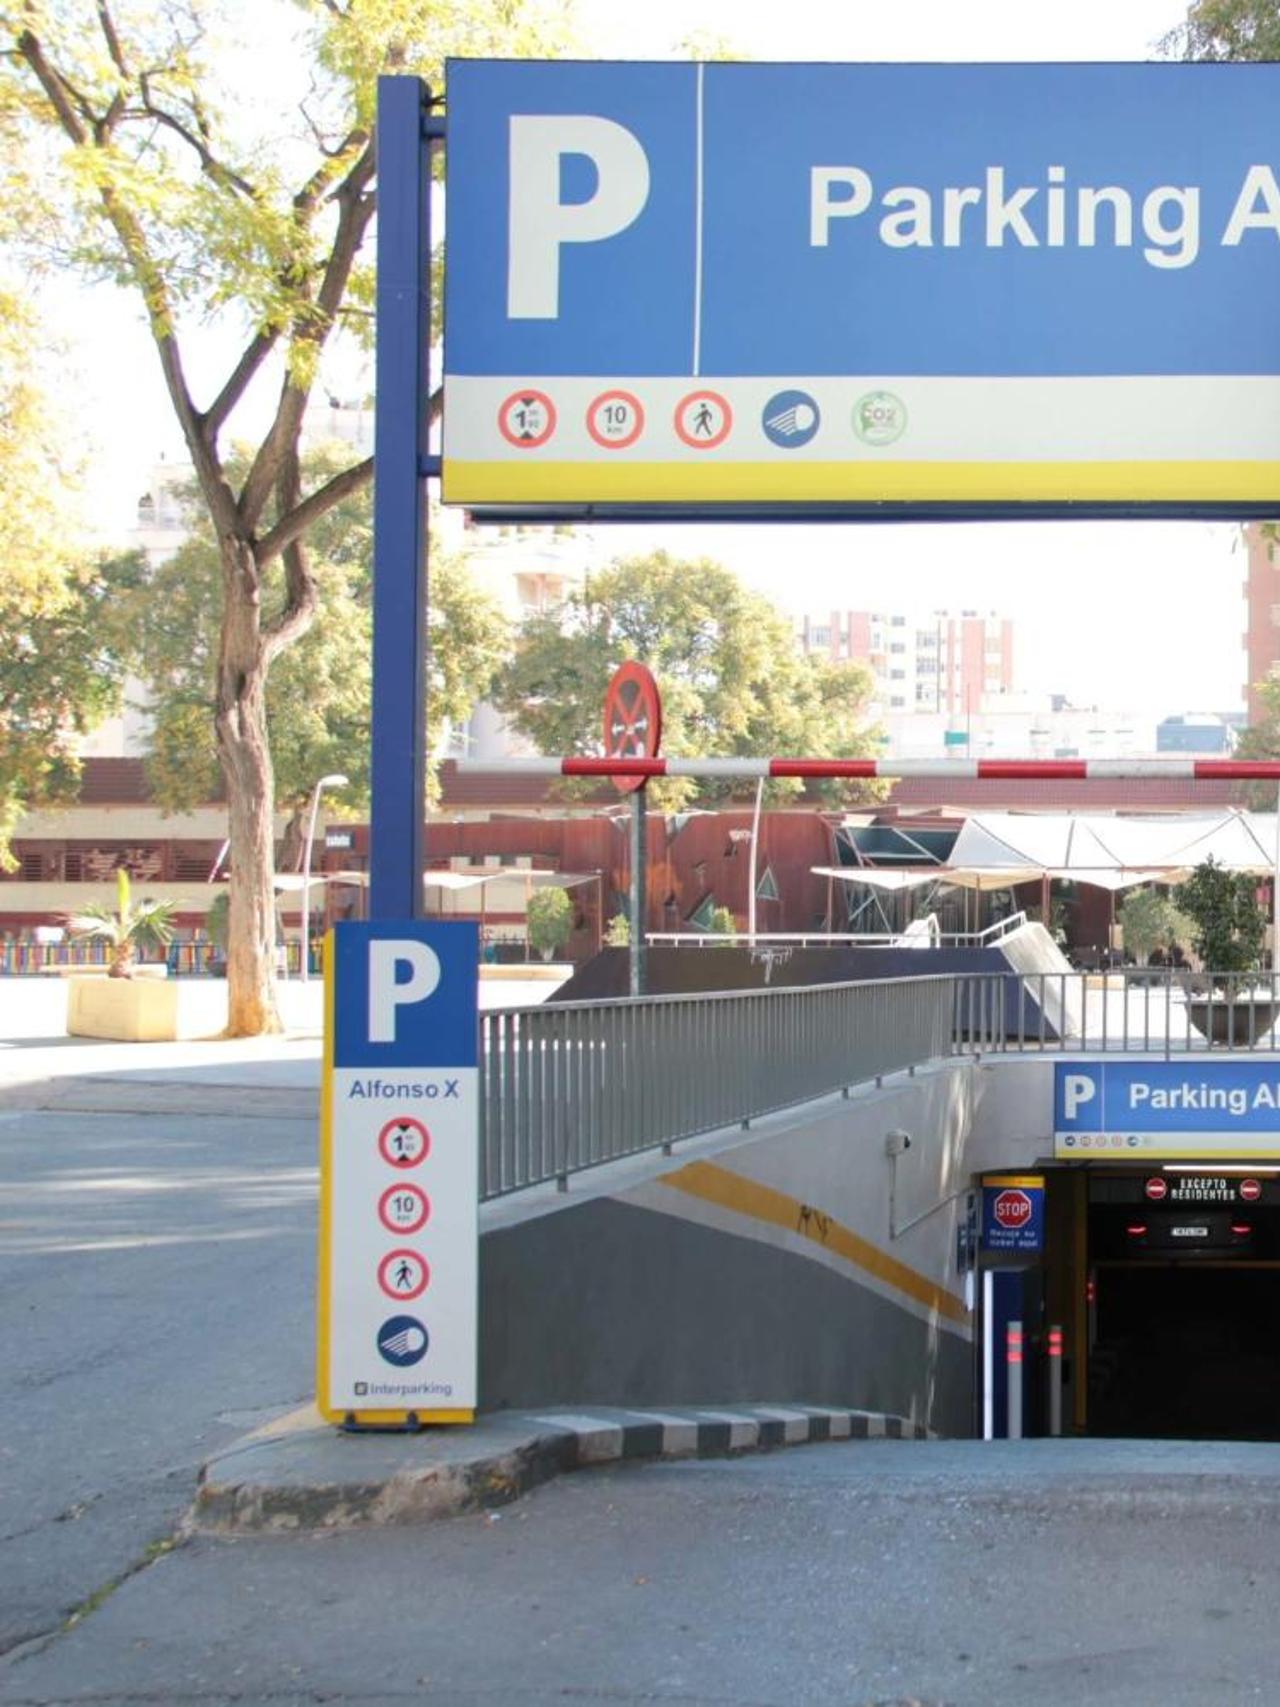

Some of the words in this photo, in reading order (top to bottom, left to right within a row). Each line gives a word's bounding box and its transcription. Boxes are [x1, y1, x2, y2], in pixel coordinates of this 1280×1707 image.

[507, 115, 650, 319] P
[810, 166, 1200, 269] Parking
[604, 405, 627, 424] 10
[368, 939, 441, 1043] P
[349, 1079, 439, 1098] Alfonso
[444, 1079, 459, 1098] X
[1064, 1075, 1096, 1119] P
[1130, 1083, 1247, 1115] Parking
[1180, 1178, 1227, 1189] EXCEPTO
[394, 1196, 415, 1212] 10
[1171, 1189, 1235, 1200] RESIDENTES
[998, 1202, 1028, 1216] STOP
[370, 1382, 453, 1397] Interparking
